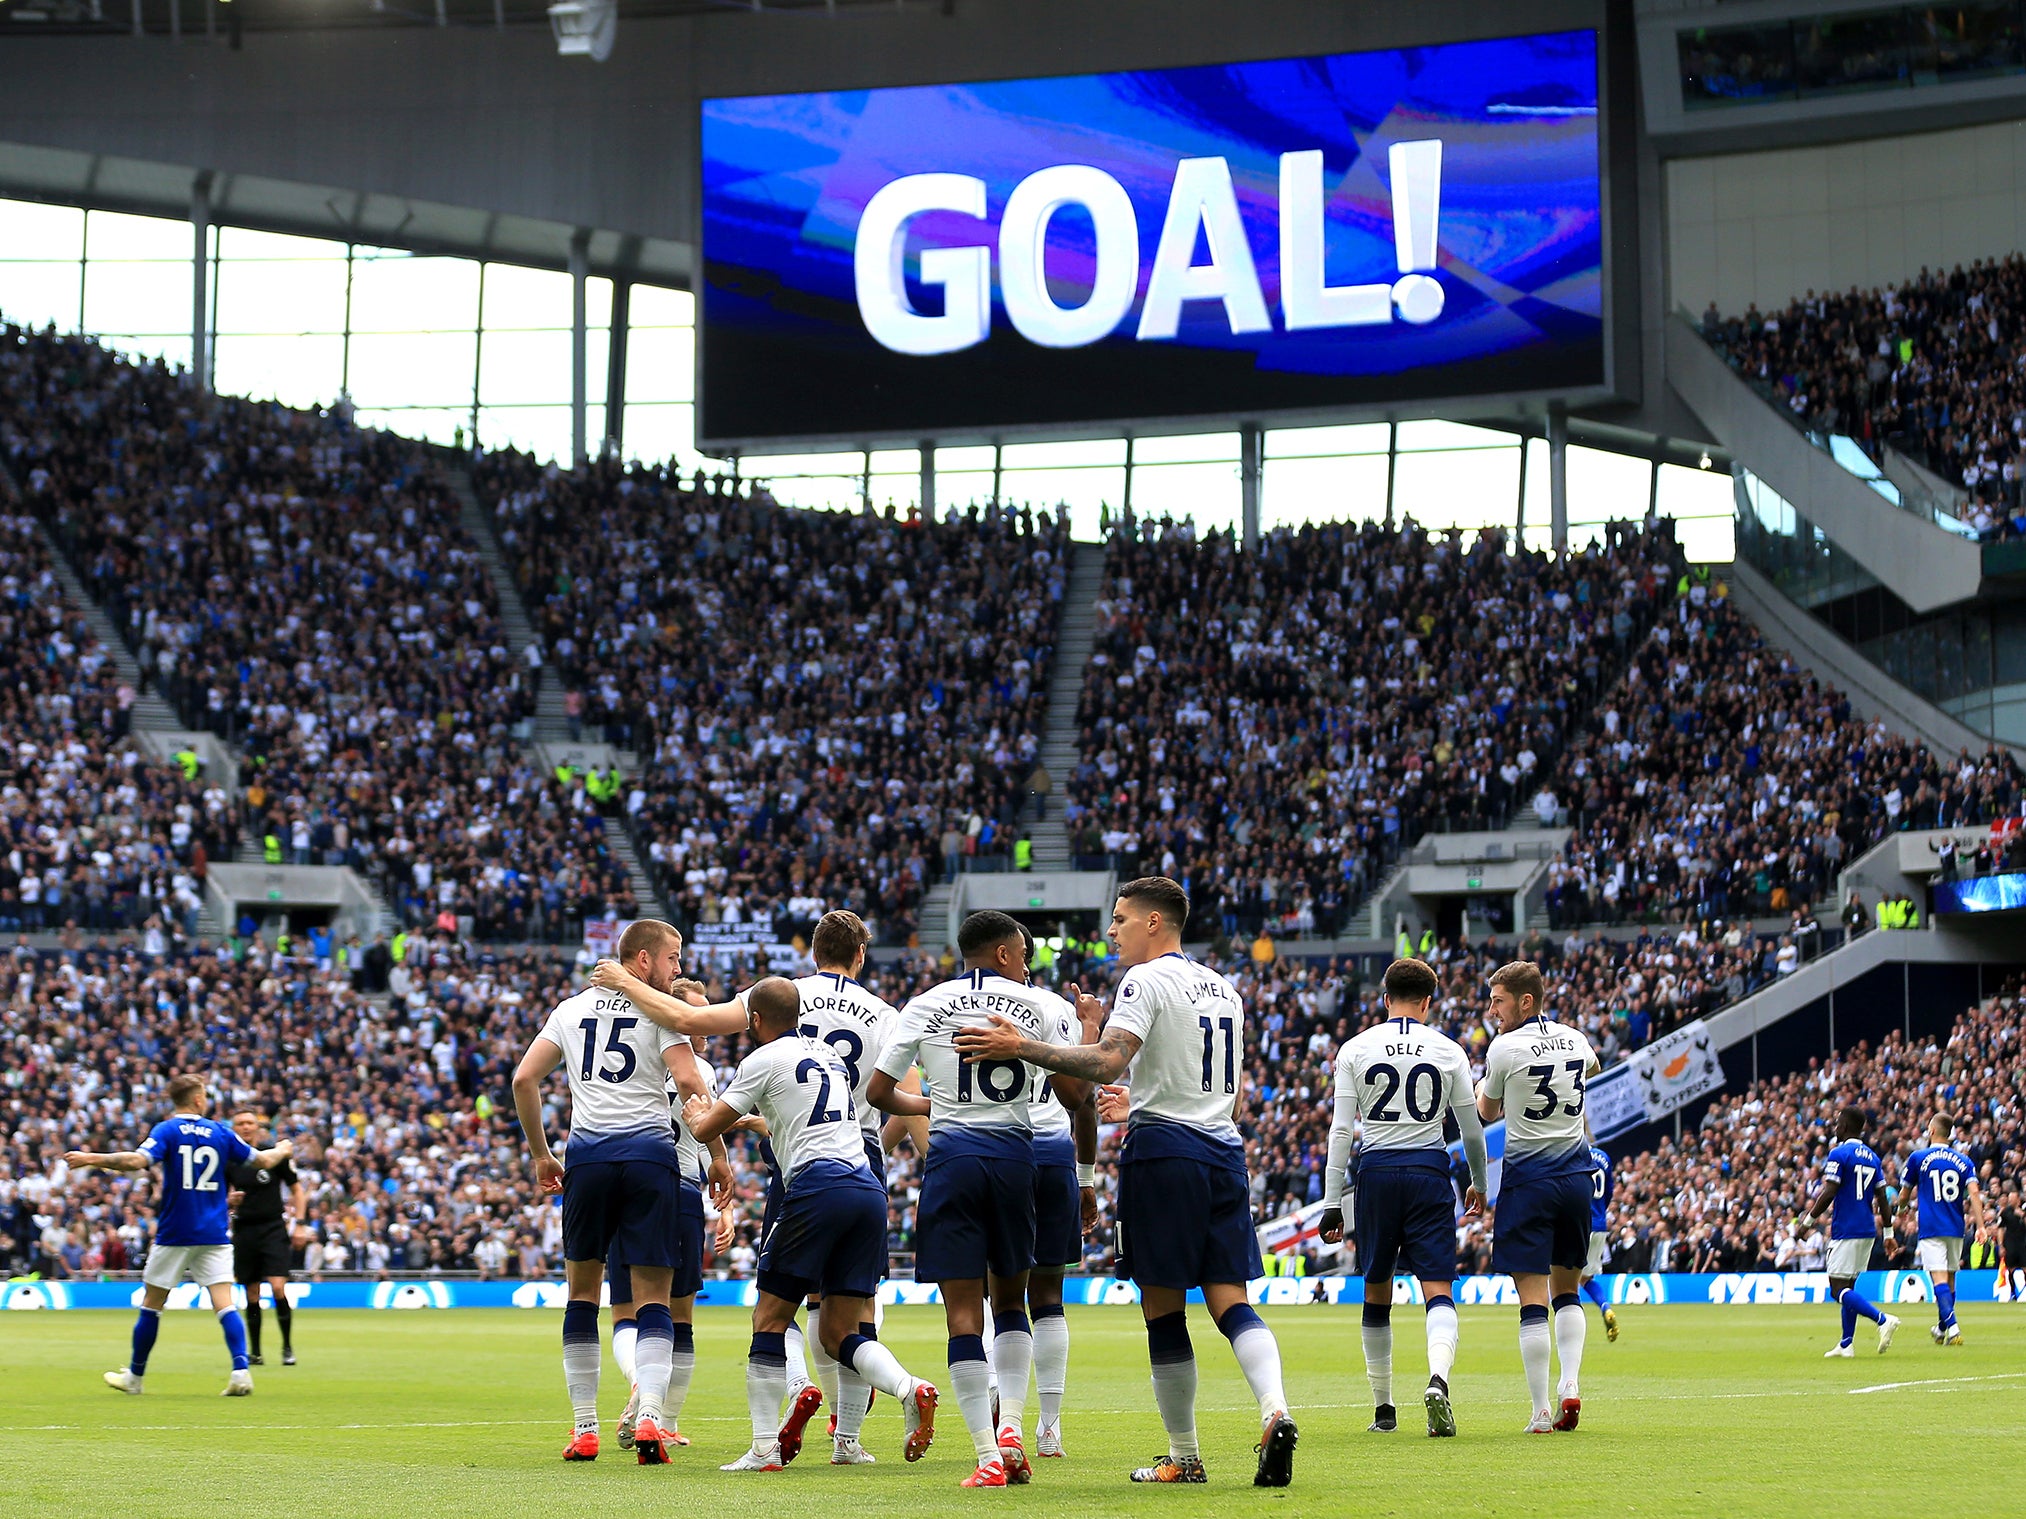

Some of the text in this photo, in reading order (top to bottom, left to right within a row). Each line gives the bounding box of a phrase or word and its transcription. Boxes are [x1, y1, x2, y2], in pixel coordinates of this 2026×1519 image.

[853, 139, 1446, 357] GOAL!
[595, 999, 632, 1013] DIER
[800, 996, 878, 1028] LORENTE
[578, 1017, 638, 1084] 15
[1199, 1015, 1235, 1094] 11
[1385, 1043, 1425, 1058] DELE
[1530, 1038, 1575, 1059] DAVIES
[1364, 1062, 1443, 1123] 20
[1523, 1059, 1585, 1121] 33
[1662, 1079, 1710, 1109] CYPRUS
[177, 1144, 220, 1192] 12
[1853, 1164, 1876, 1201] 17
[1929, 1169, 1960, 1203] 18
